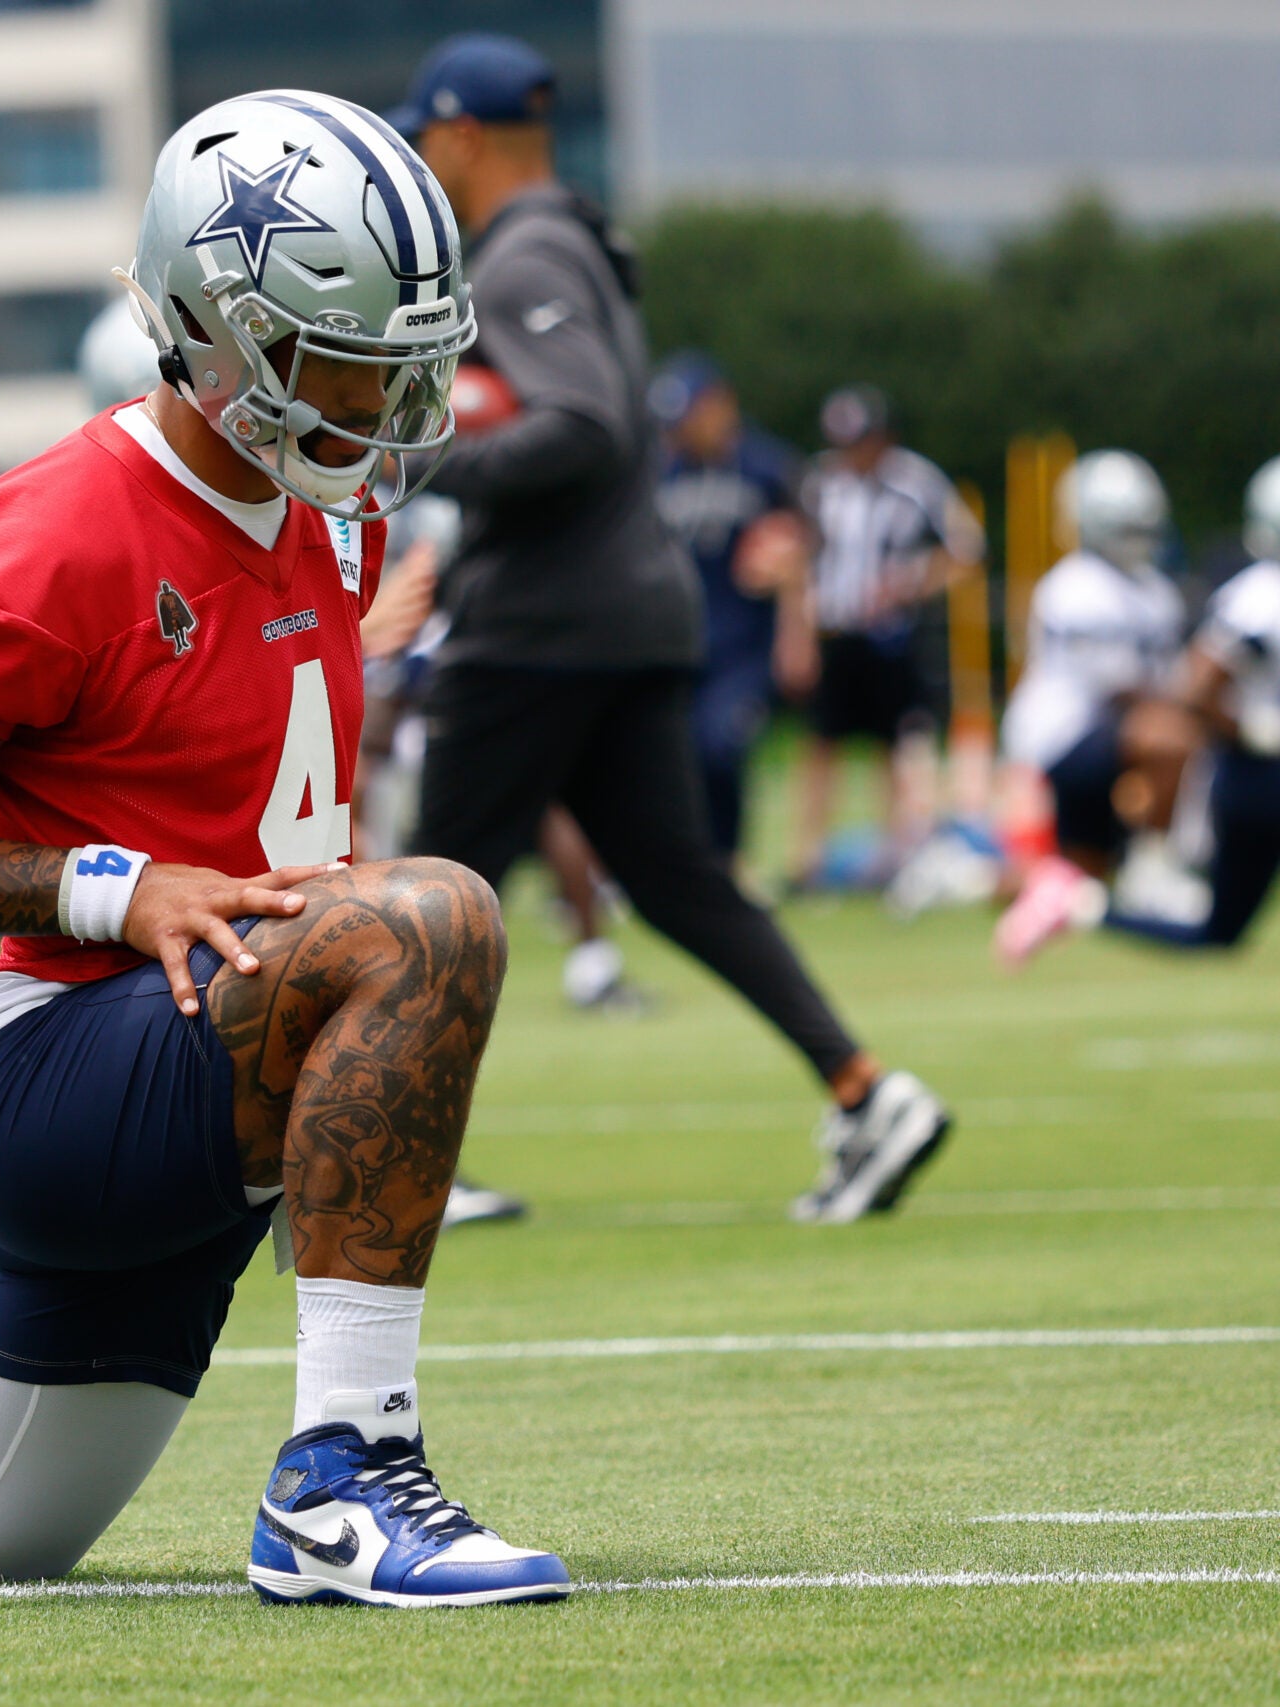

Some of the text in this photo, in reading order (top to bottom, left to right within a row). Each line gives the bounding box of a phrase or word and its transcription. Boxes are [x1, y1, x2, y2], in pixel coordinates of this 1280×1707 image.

[406, 307, 451, 326] COWBOYS
[340, 558, 358, 582] AT&T
[262, 609, 318, 642] COWBOYS
[258, 658, 351, 872] 4
[76, 850, 132, 877] 4
[388, 1390, 407, 1404] NIKE
[400, 1400, 412, 1412] AIR
